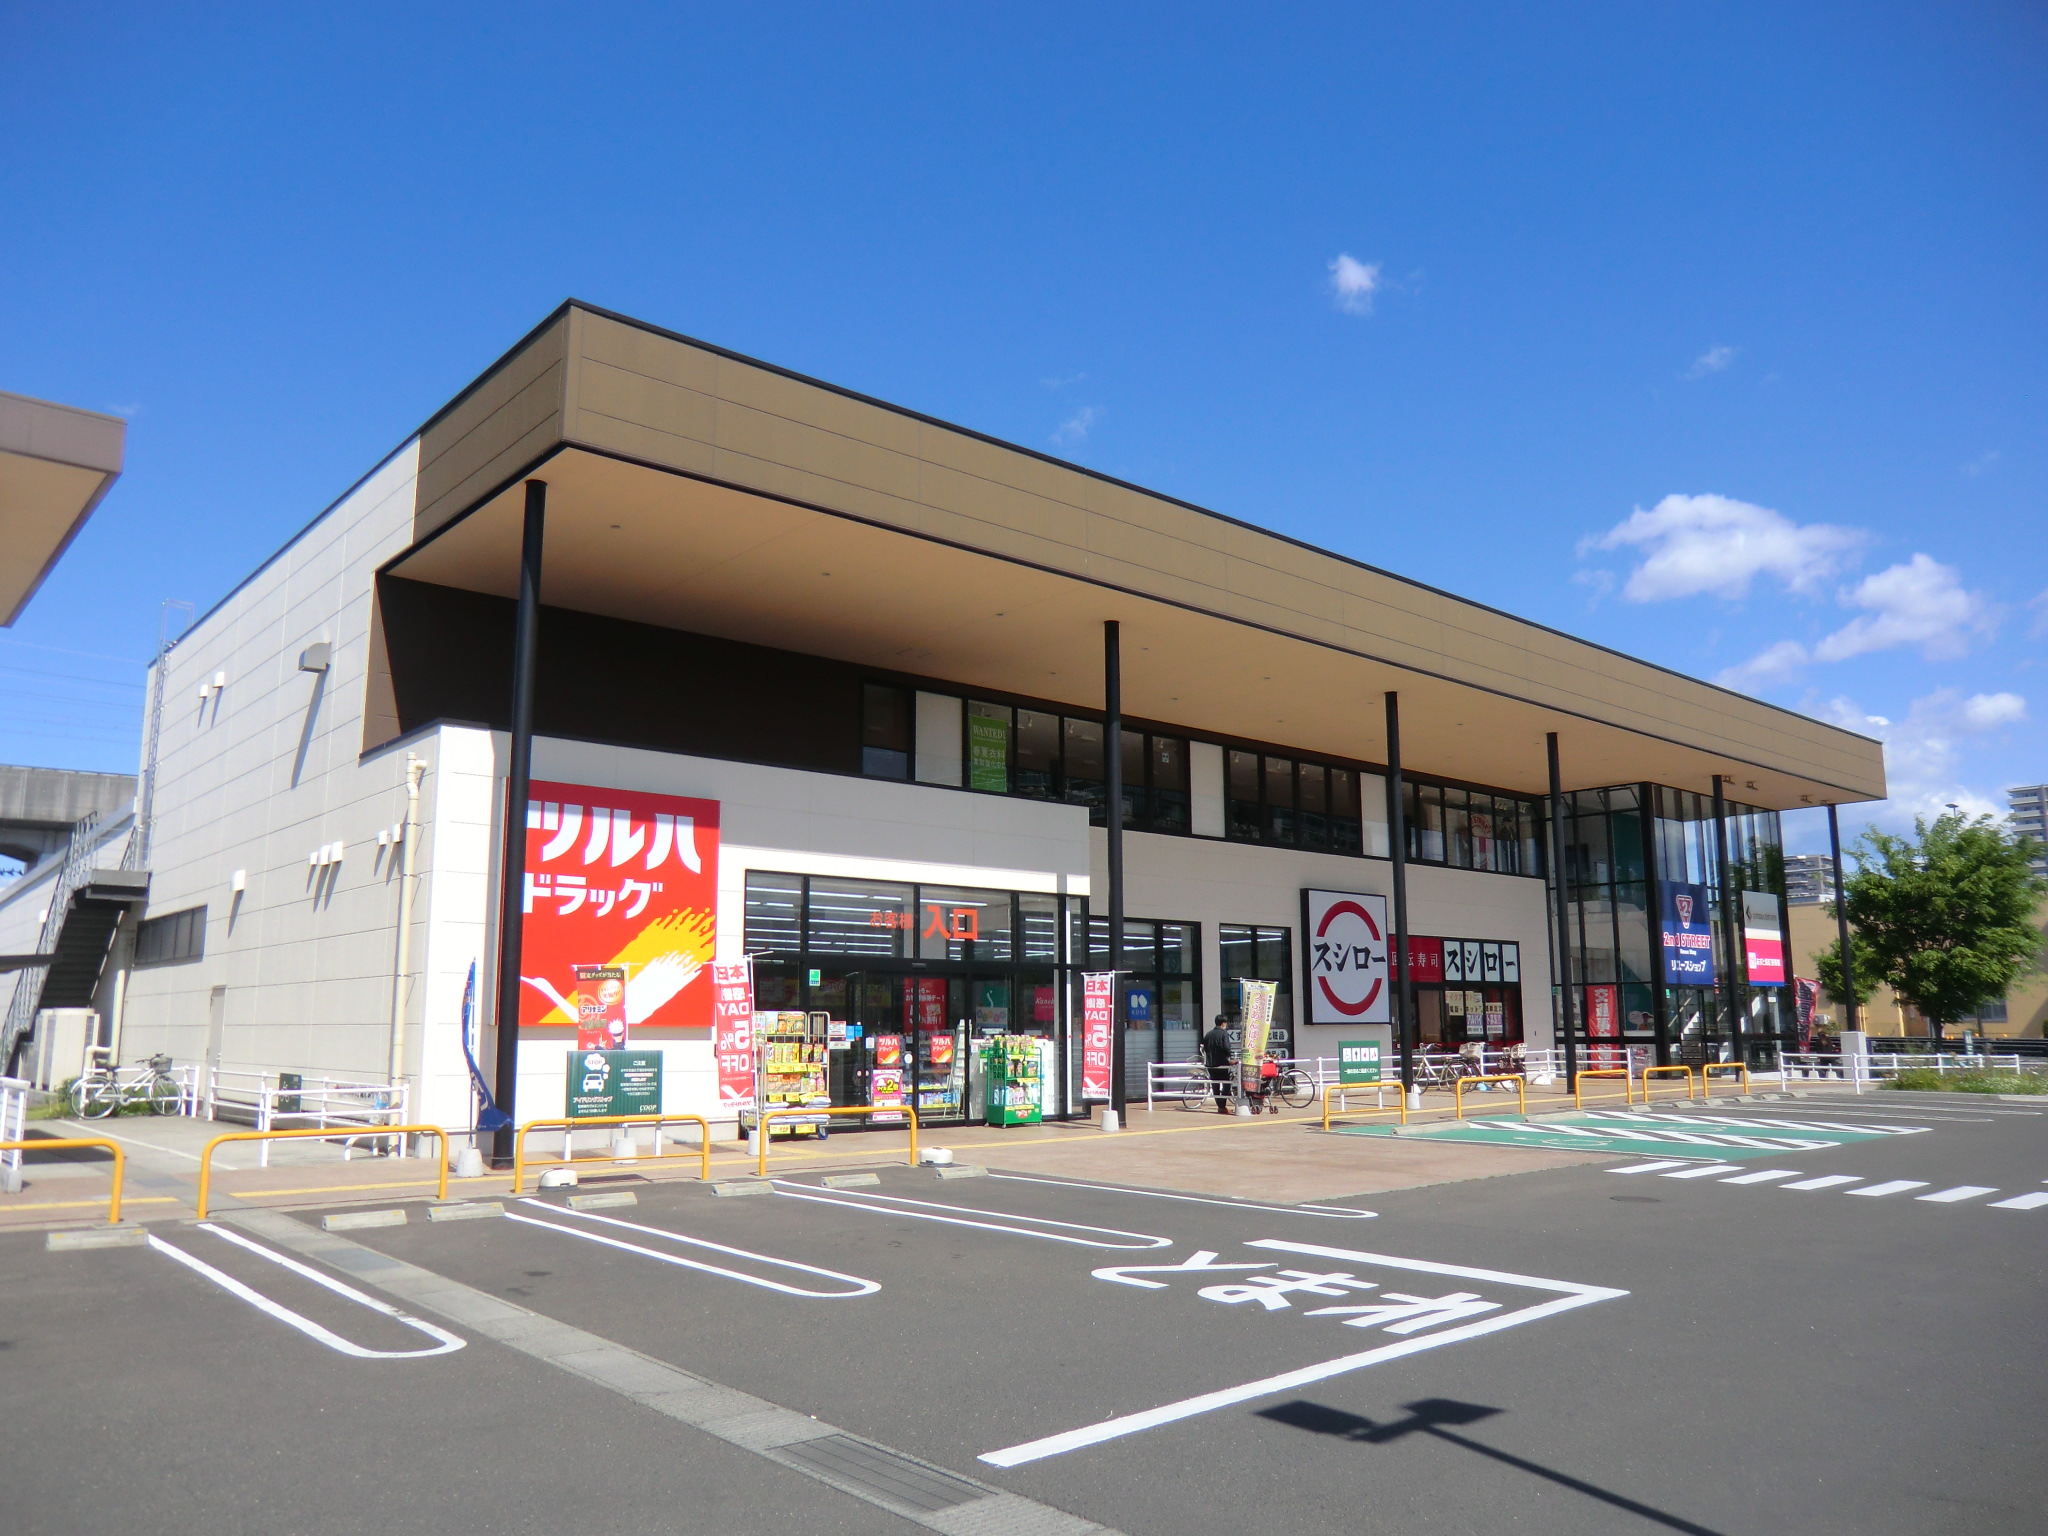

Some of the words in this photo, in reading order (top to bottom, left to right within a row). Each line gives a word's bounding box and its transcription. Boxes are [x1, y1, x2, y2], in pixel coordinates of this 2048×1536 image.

[972, 725, 1005, 739] WANTED!
[527, 799, 702, 875] ツルハ
[522, 871, 664, 920] ドラッグ
[869, 911, 914, 930] お客様
[922, 904, 978, 941] 入口
[1663, 931, 1680, 947] 2nd
[1681, 933, 1711, 949] STREET
[1311, 940, 1387, 973] スシロー
[1445, 948, 1517, 975] スシロー
[1671, 959, 1707, 972] リユースショップ
[879, 1037, 898, 1046] ツルハ
[932, 1037, 951, 1046] ツルハ
[1090, 1249, 1504, 1335] とまれ
